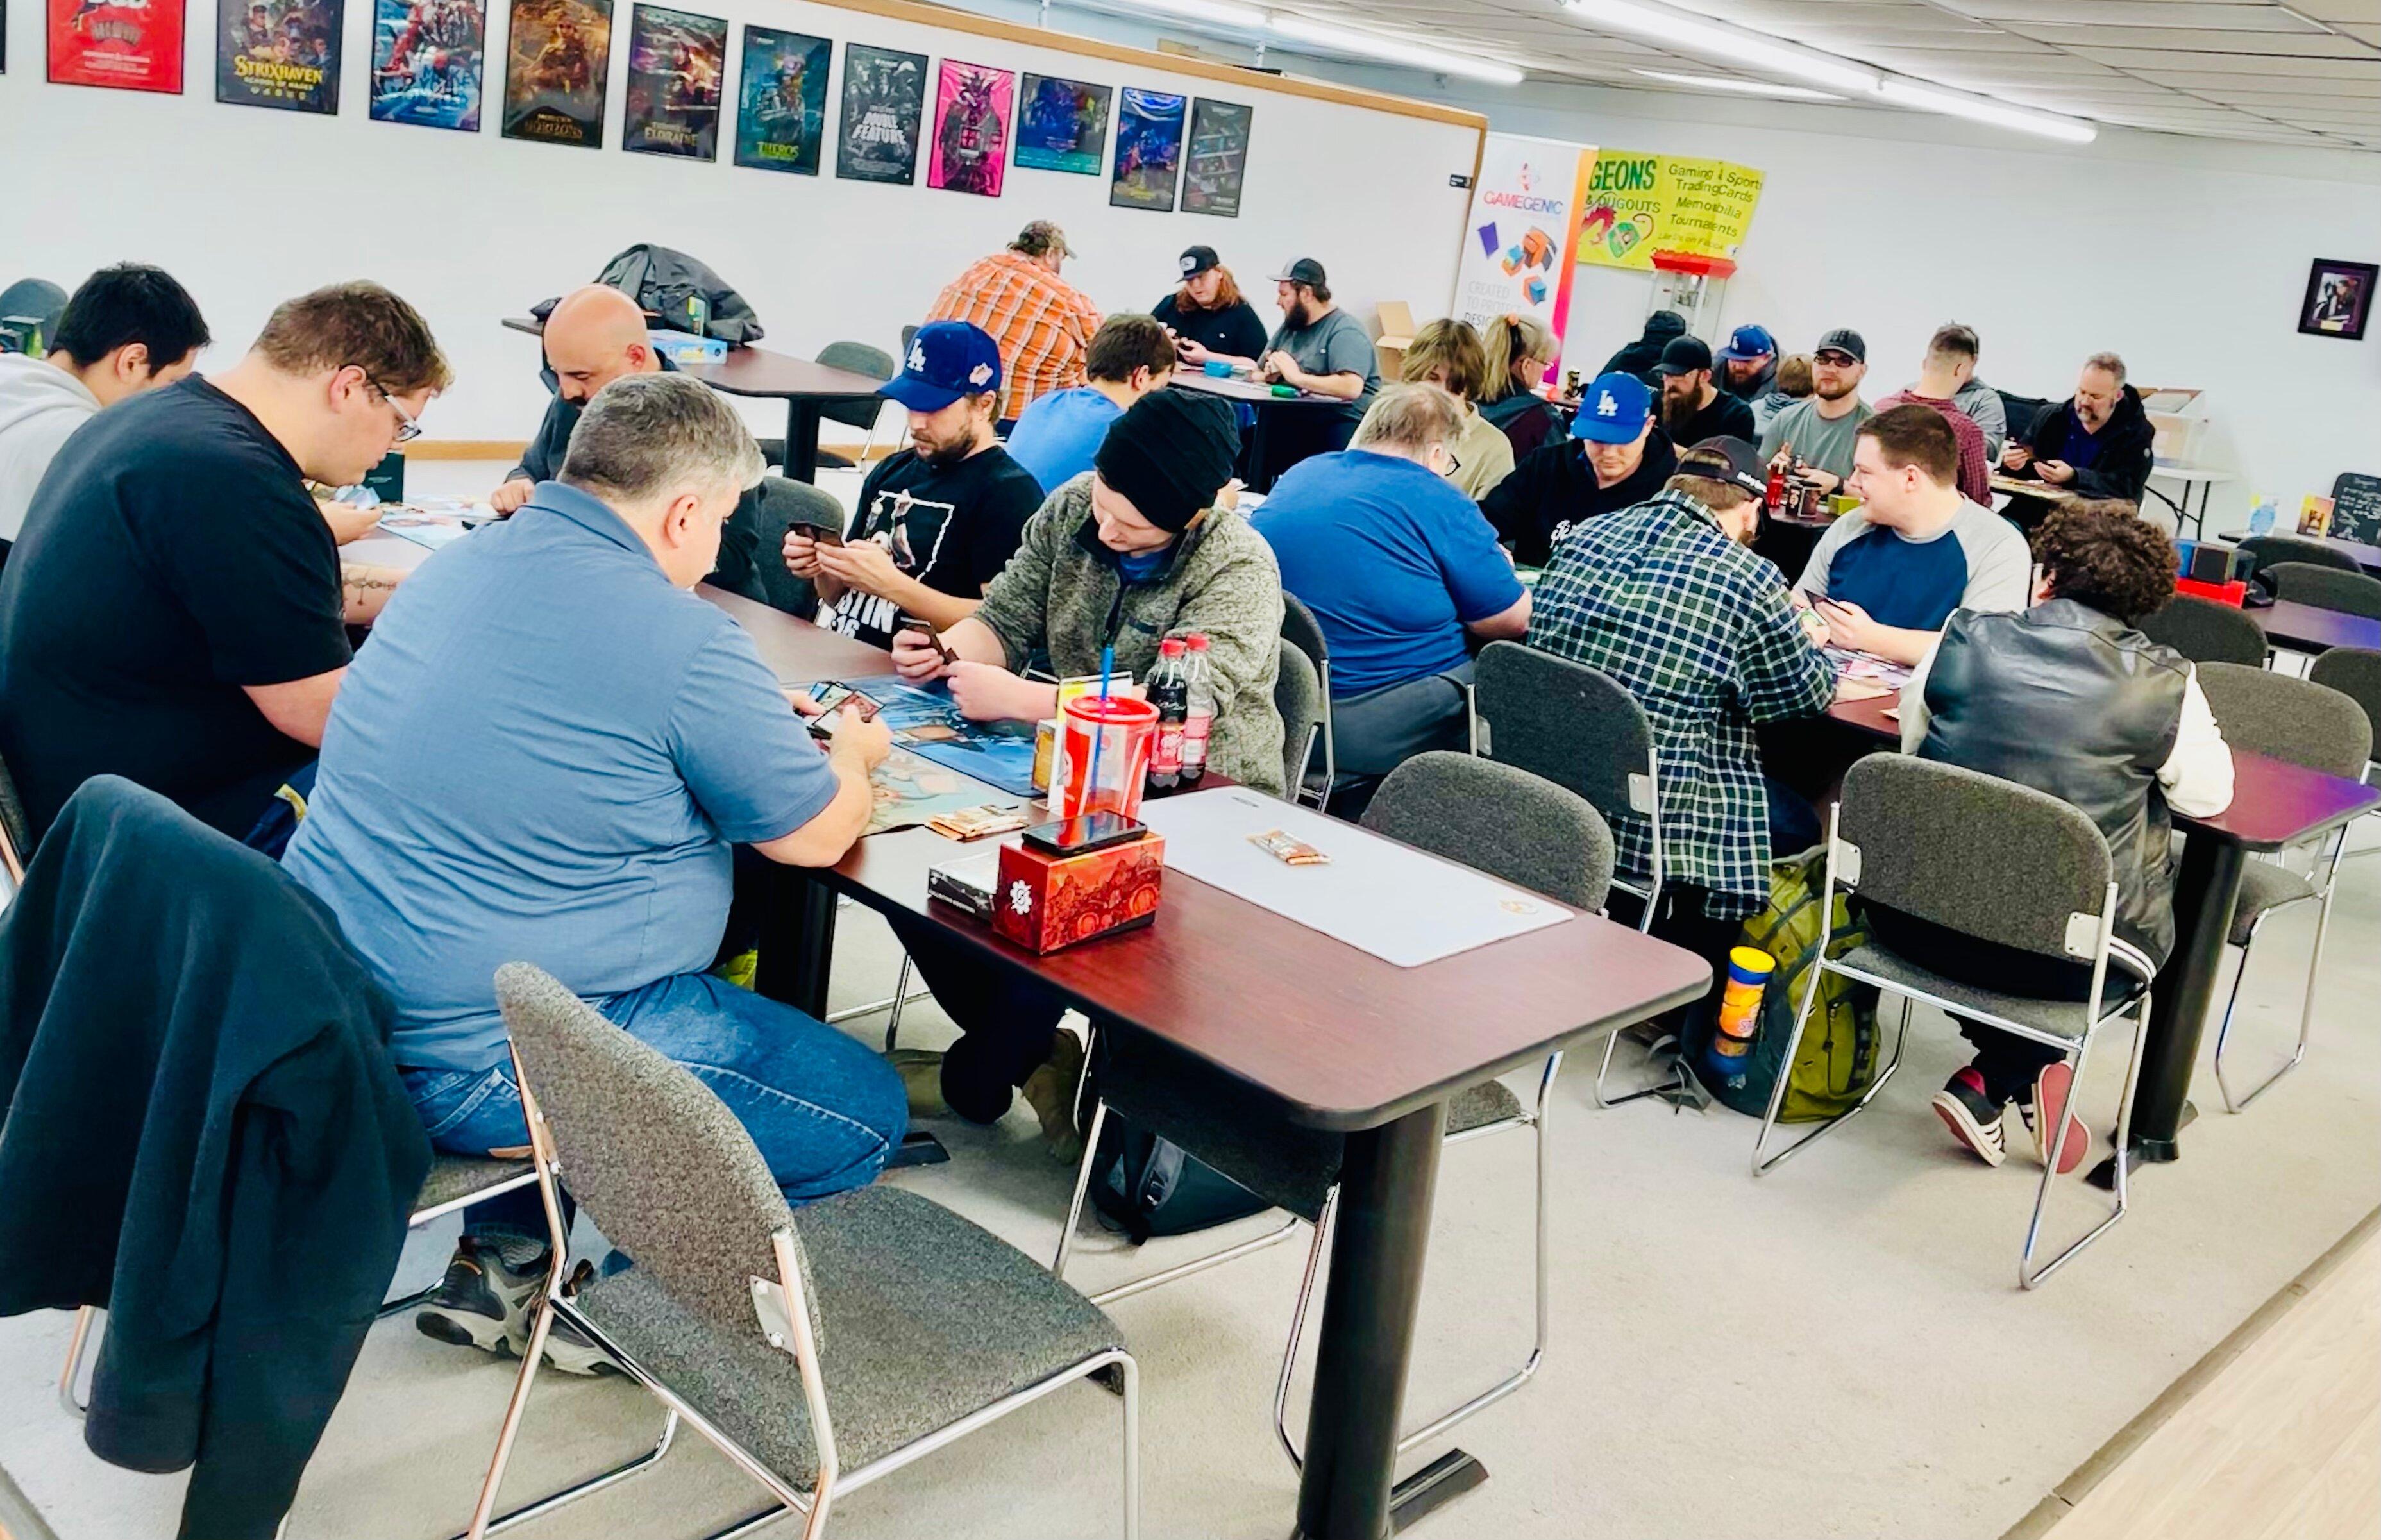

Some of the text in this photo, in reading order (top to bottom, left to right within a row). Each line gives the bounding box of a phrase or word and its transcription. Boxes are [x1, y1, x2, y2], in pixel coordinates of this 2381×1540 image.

[851, 124, 907, 146] FEATURE
[1588, 159, 1657, 190] GEONS
[1669, 163, 1714, 181] Gaming
[1484, 191, 1563, 215] GAMEGENIC
[907, 338, 927, 372] LA
[1597, 390, 1619, 417] LA
